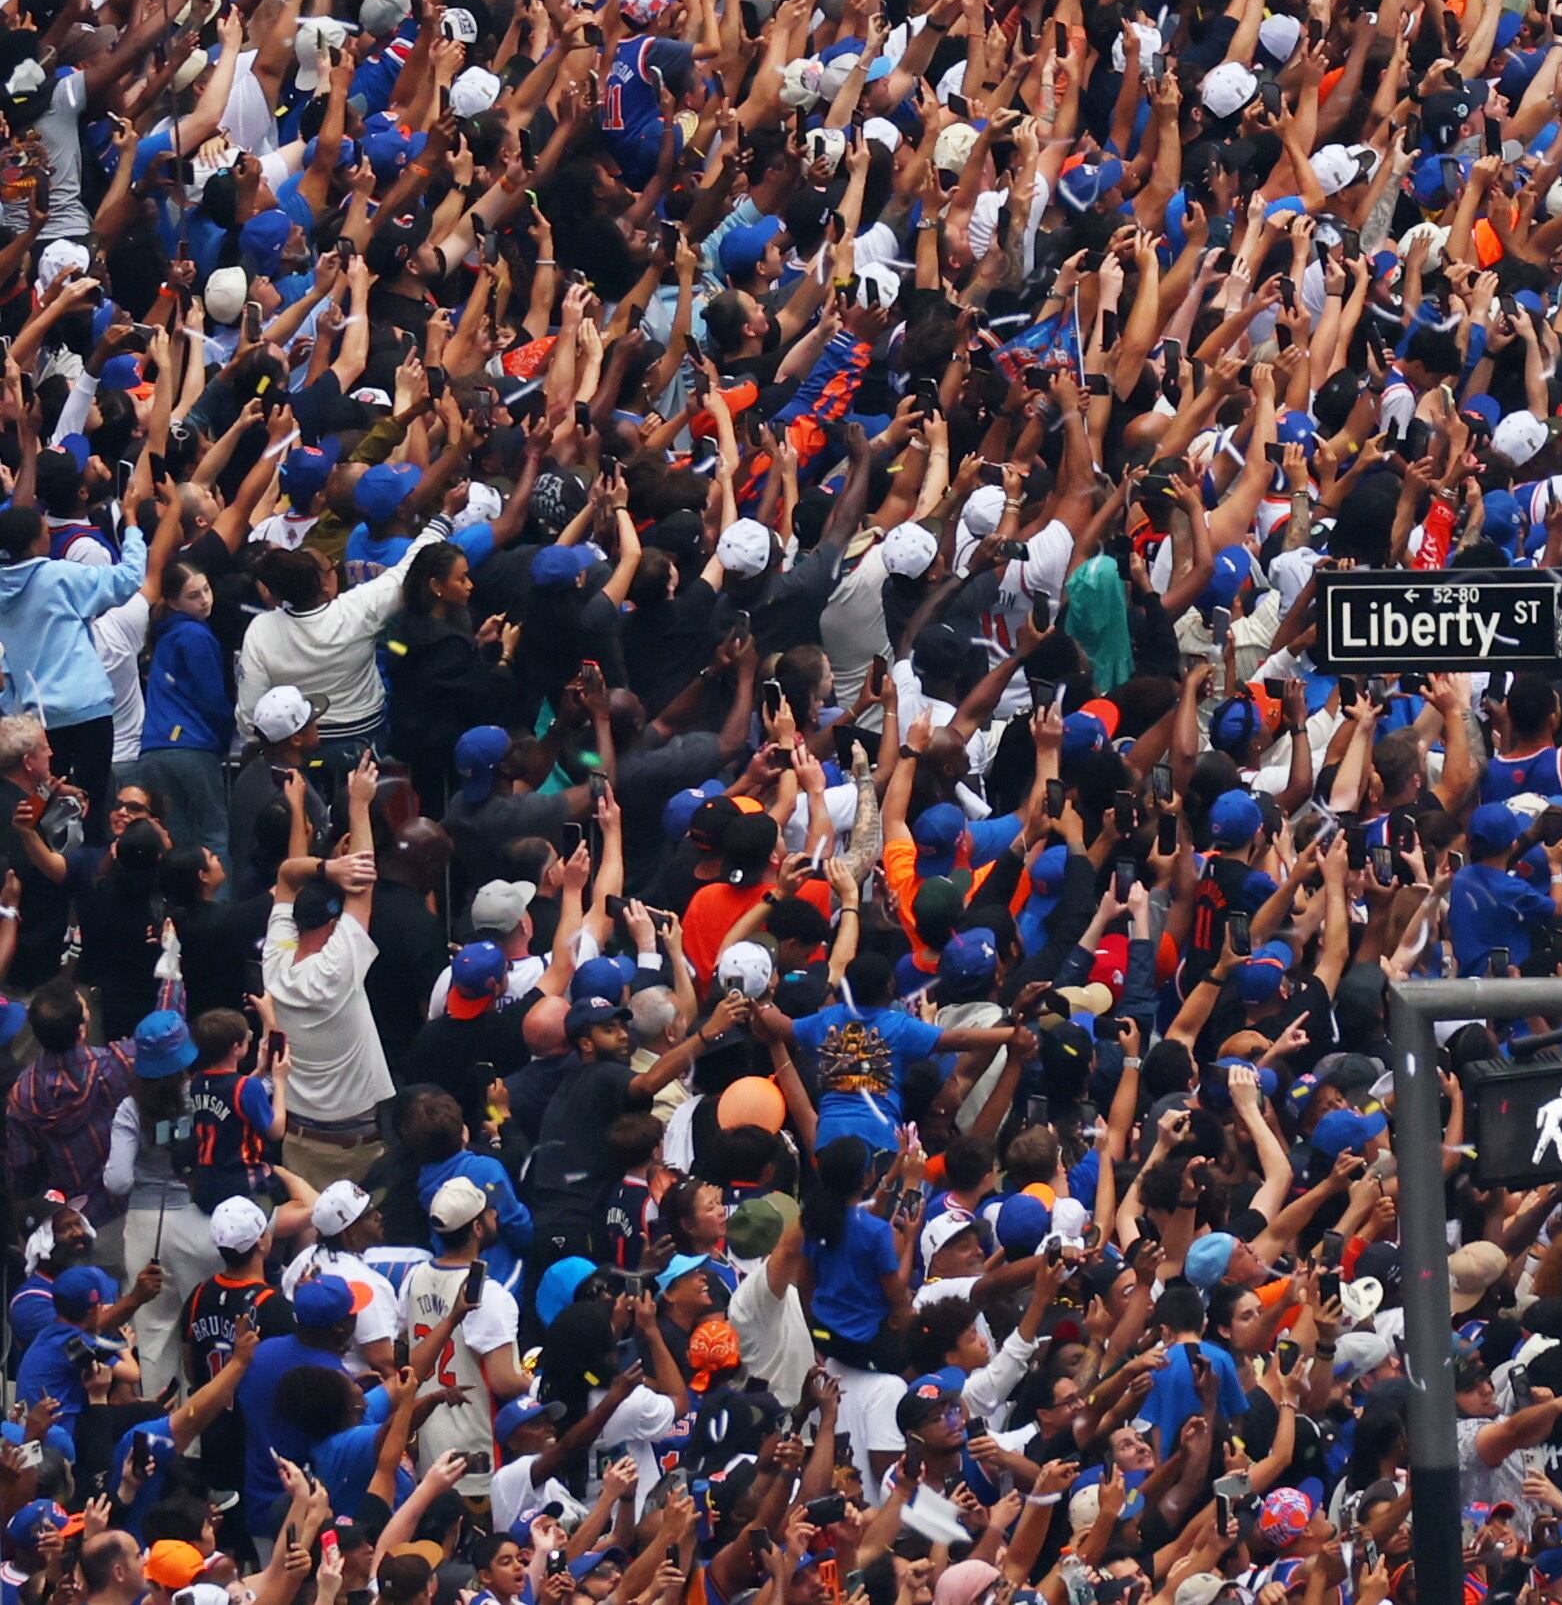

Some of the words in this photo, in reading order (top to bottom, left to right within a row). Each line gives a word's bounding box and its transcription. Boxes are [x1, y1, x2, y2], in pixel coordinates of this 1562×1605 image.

[1432, 586, 1480, 604] 52-80
[1341, 601, 1497, 659] Liberty
[1514, 601, 1541, 624] ST
